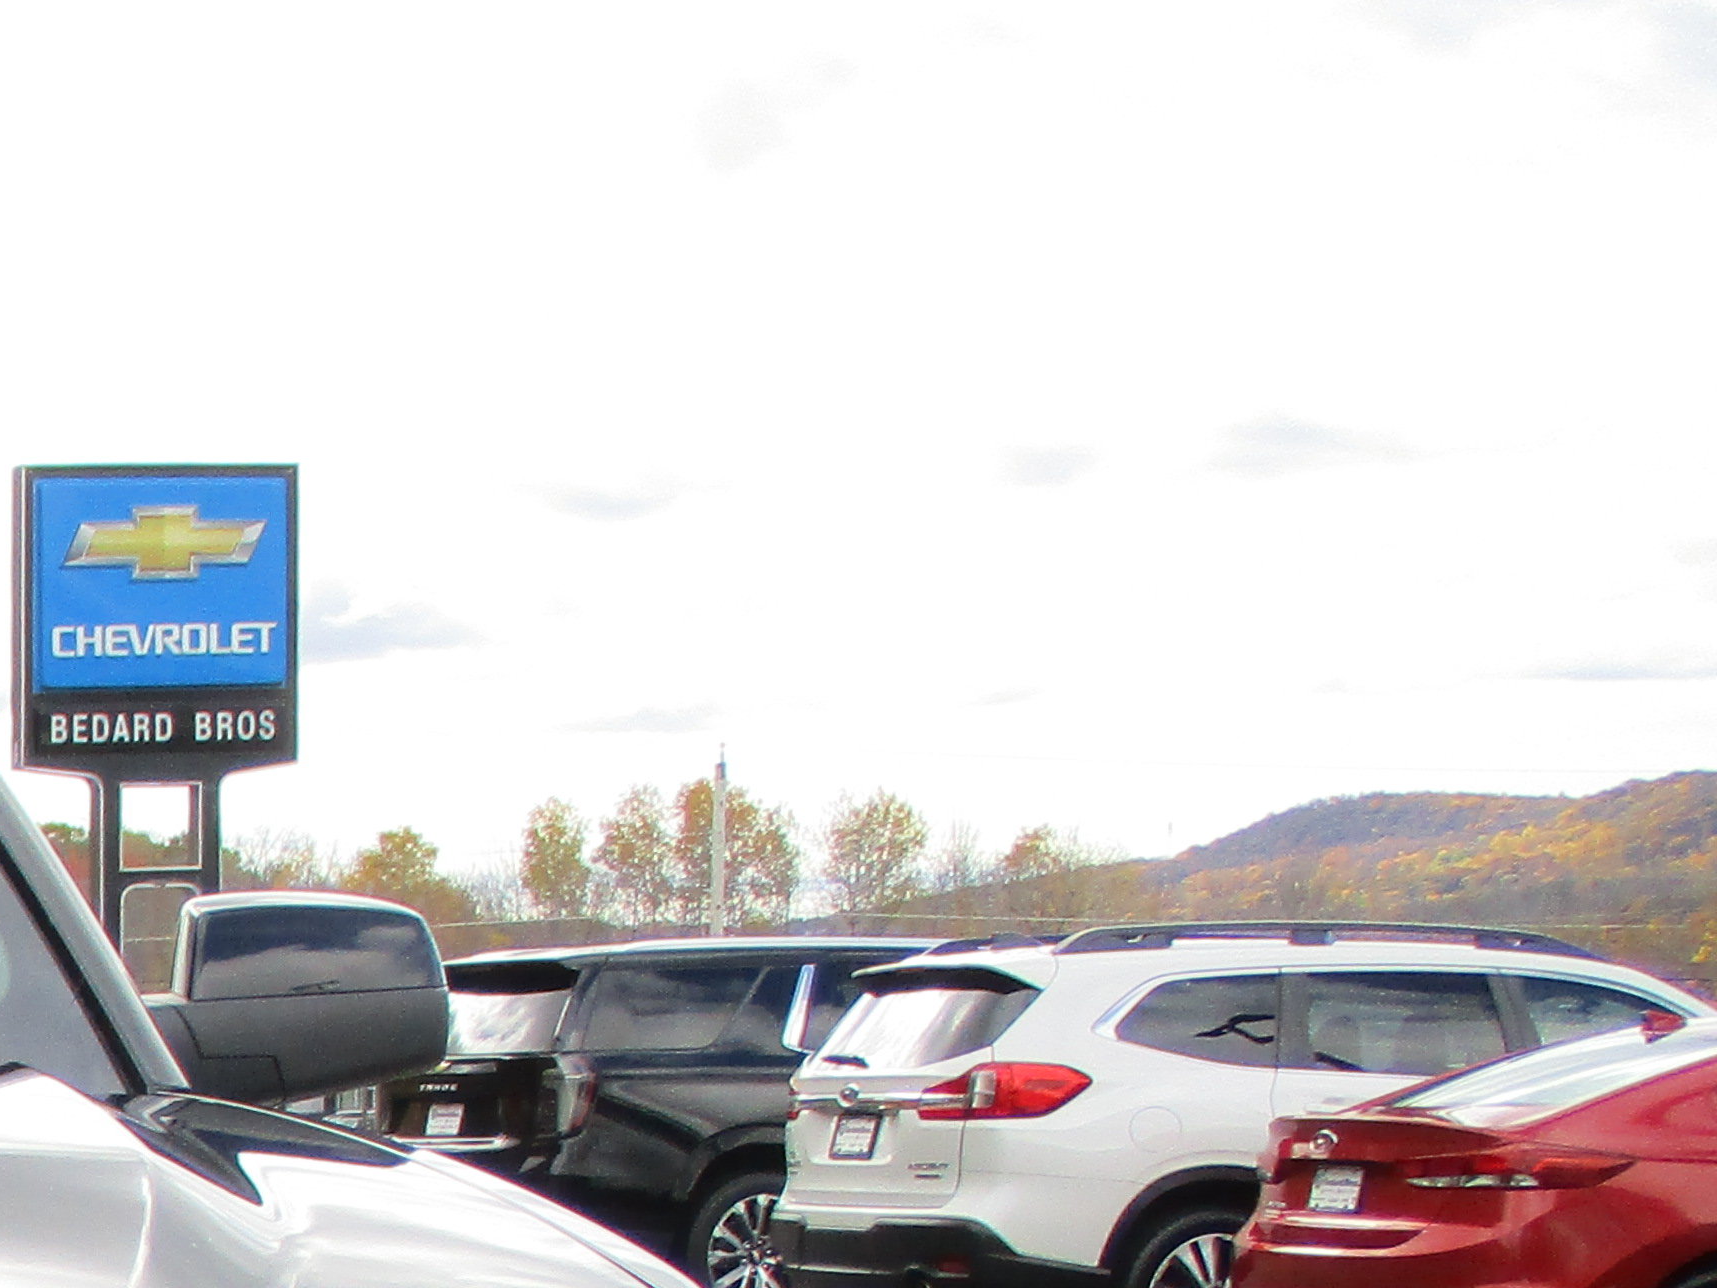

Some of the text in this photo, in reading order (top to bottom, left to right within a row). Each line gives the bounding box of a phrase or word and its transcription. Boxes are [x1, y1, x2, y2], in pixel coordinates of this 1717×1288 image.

[50, 621, 278, 659] CHEVROLET
[50, 709, 277, 744] BEDARD BROS
